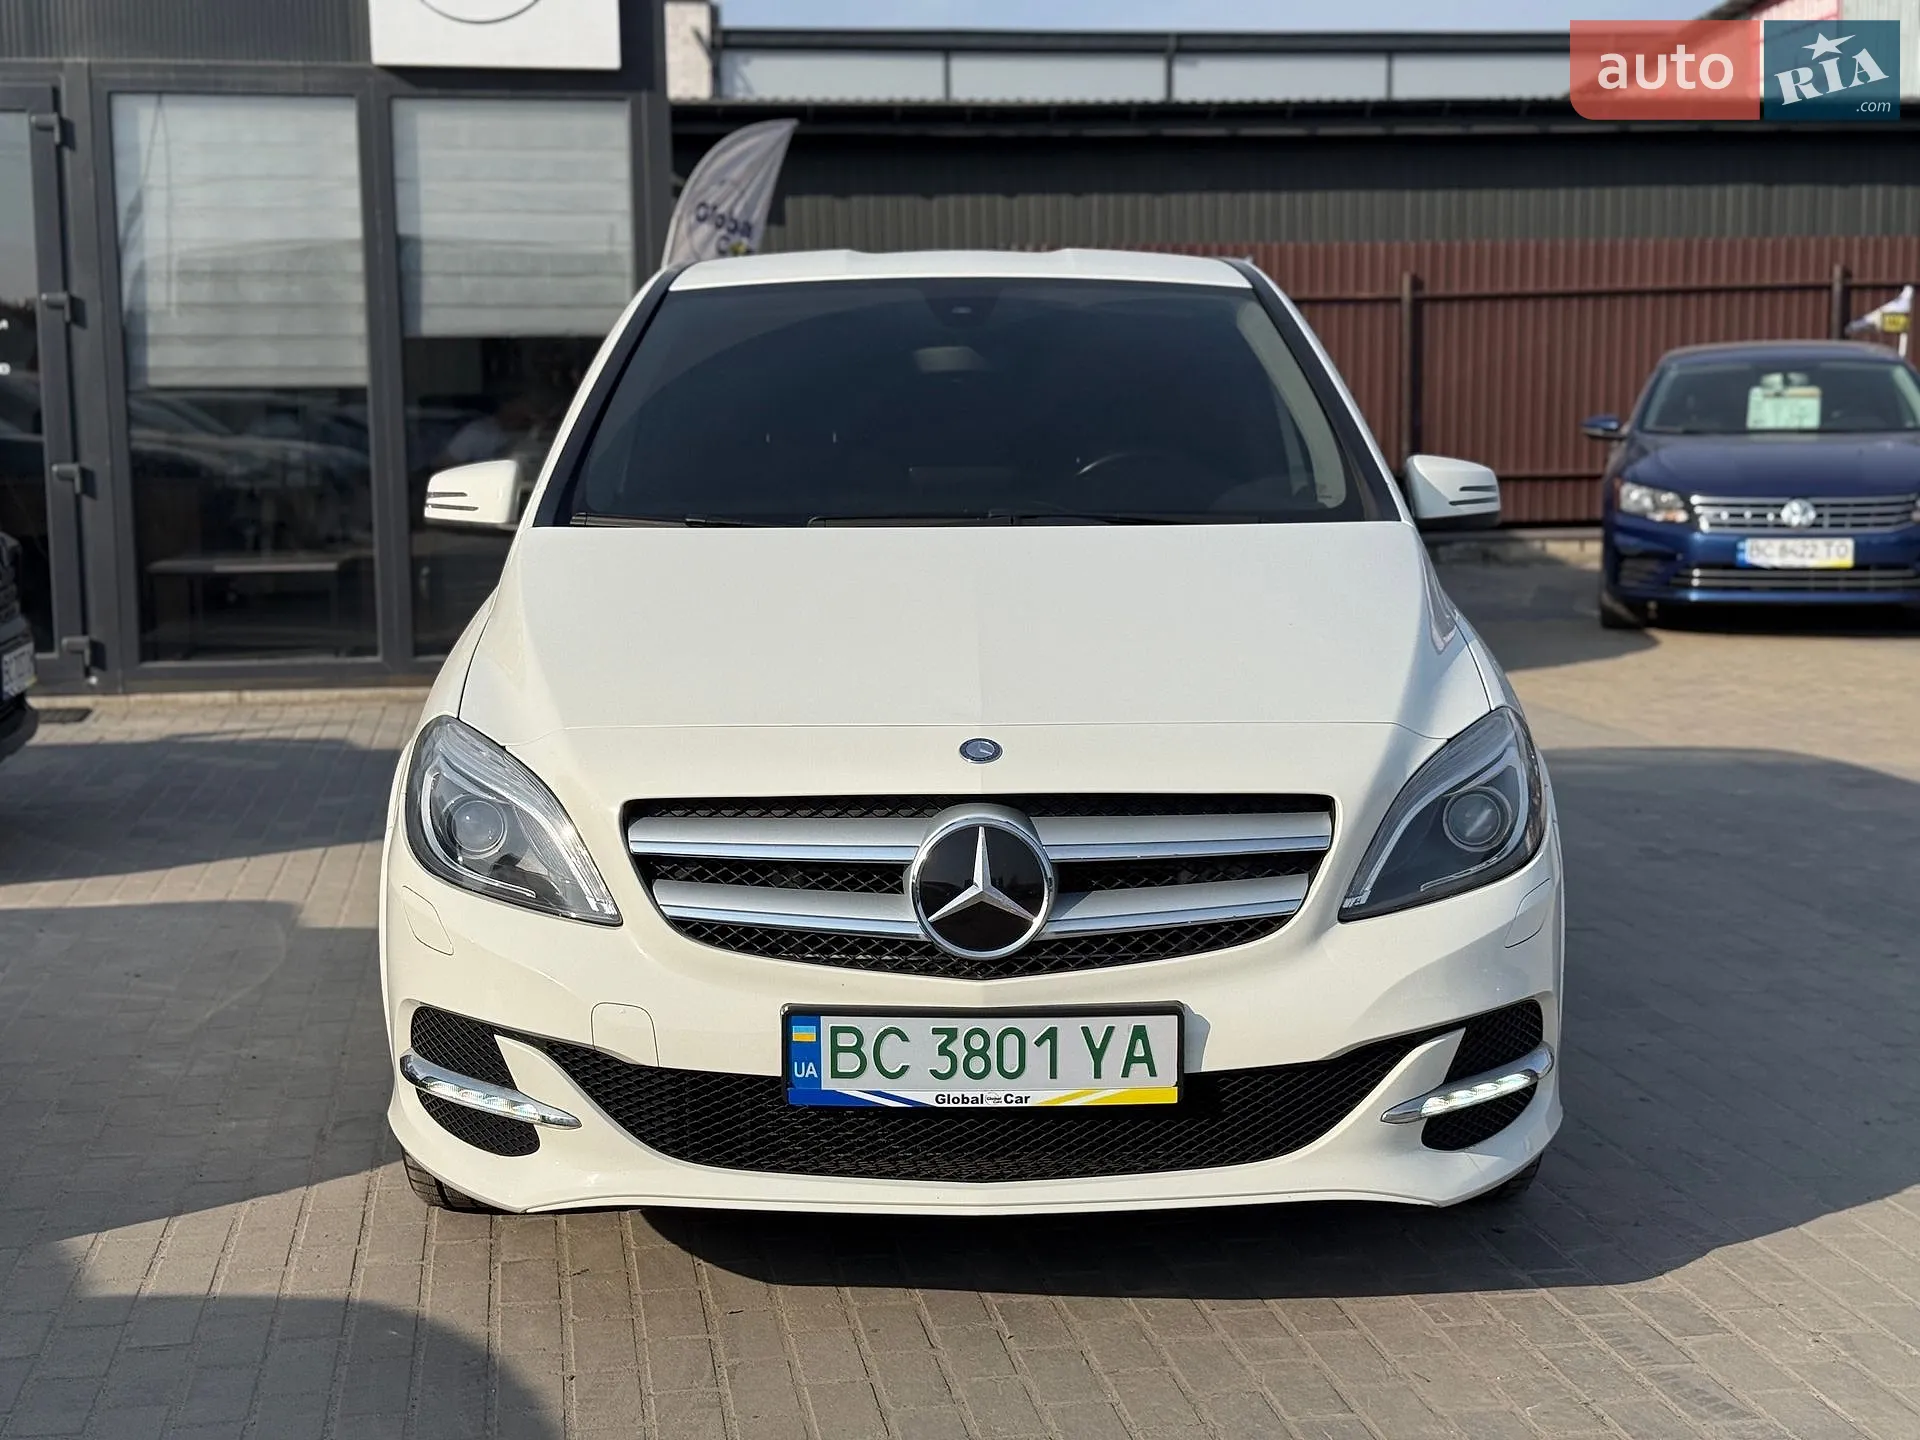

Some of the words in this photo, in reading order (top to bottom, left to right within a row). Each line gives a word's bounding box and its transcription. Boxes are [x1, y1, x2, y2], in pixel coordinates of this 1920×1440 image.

[829, 1024, 910, 1080] BC
[928, 1024, 1058, 1081] 3801
[1080, 1024, 1158, 1079] YA
[793, 1061, 818, 1079] UA
[934, 1093, 984, 1105] Global
[1003, 1093, 1031, 1104] Car
